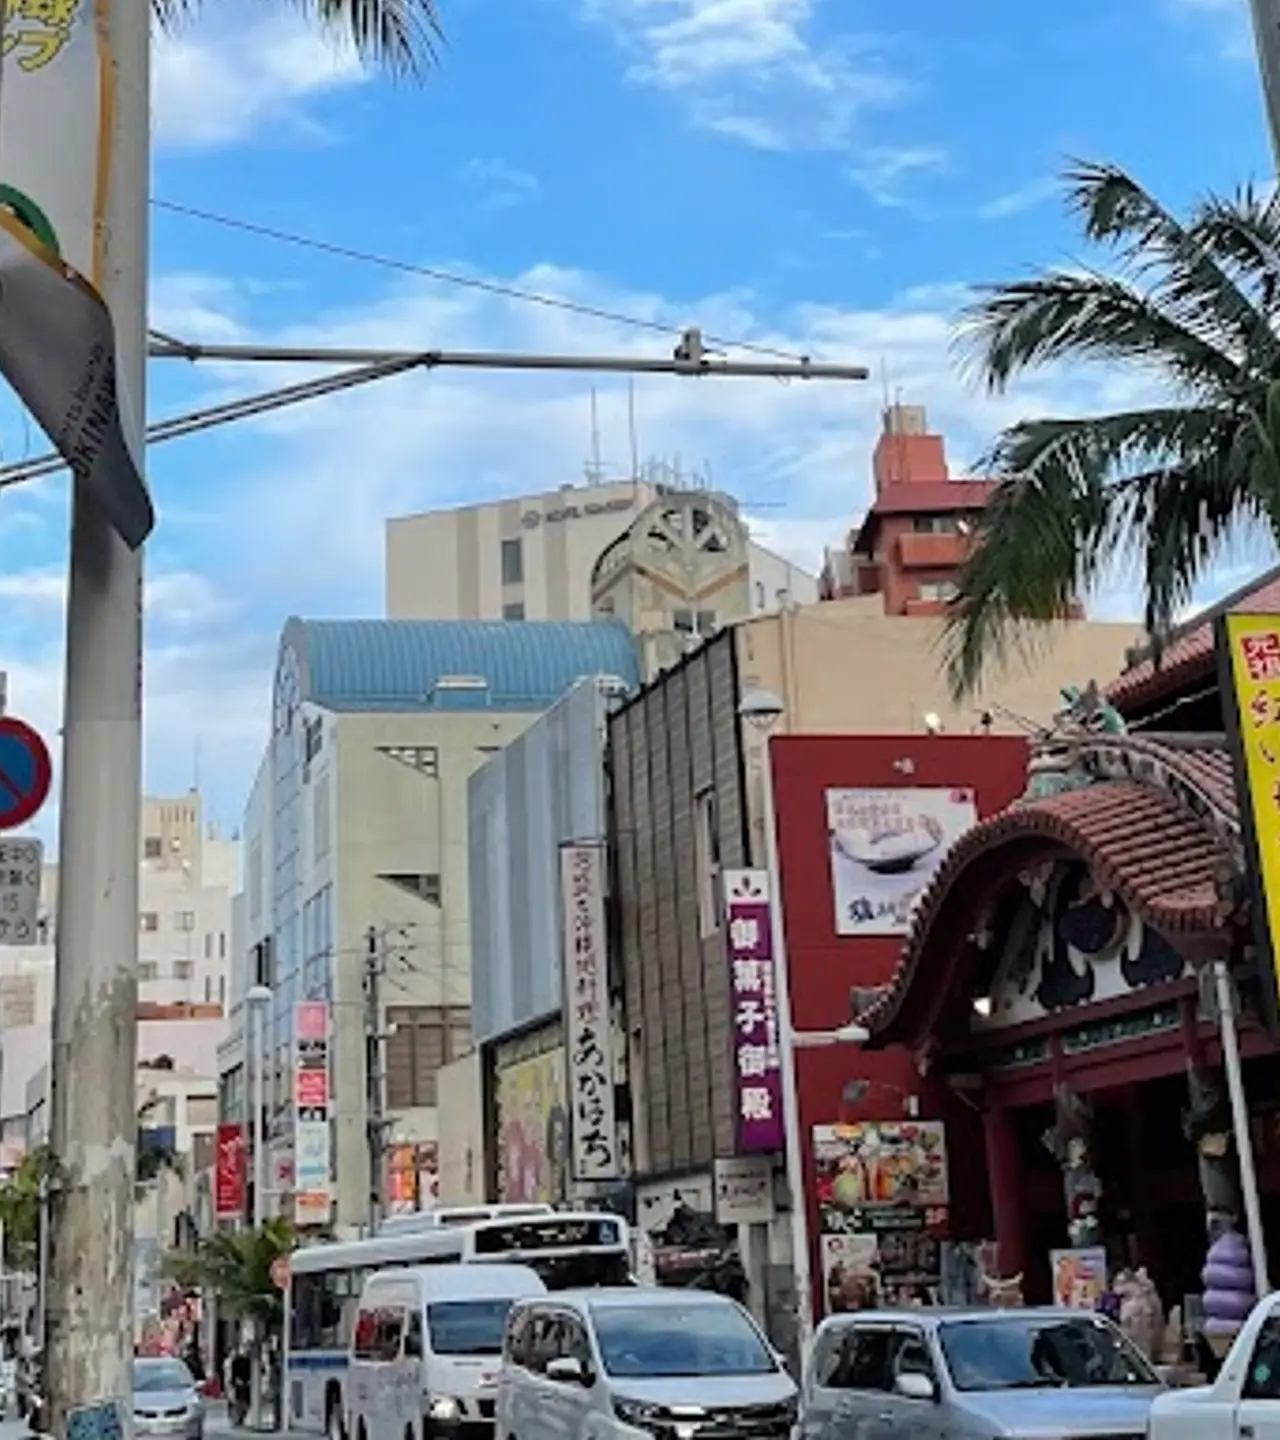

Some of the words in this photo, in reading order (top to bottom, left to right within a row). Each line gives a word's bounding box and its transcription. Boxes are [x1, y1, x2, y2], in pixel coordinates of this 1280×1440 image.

[573, 1027, 612, 1168] あかはち
[729, 917, 773, 1121] 御菓子御殿
